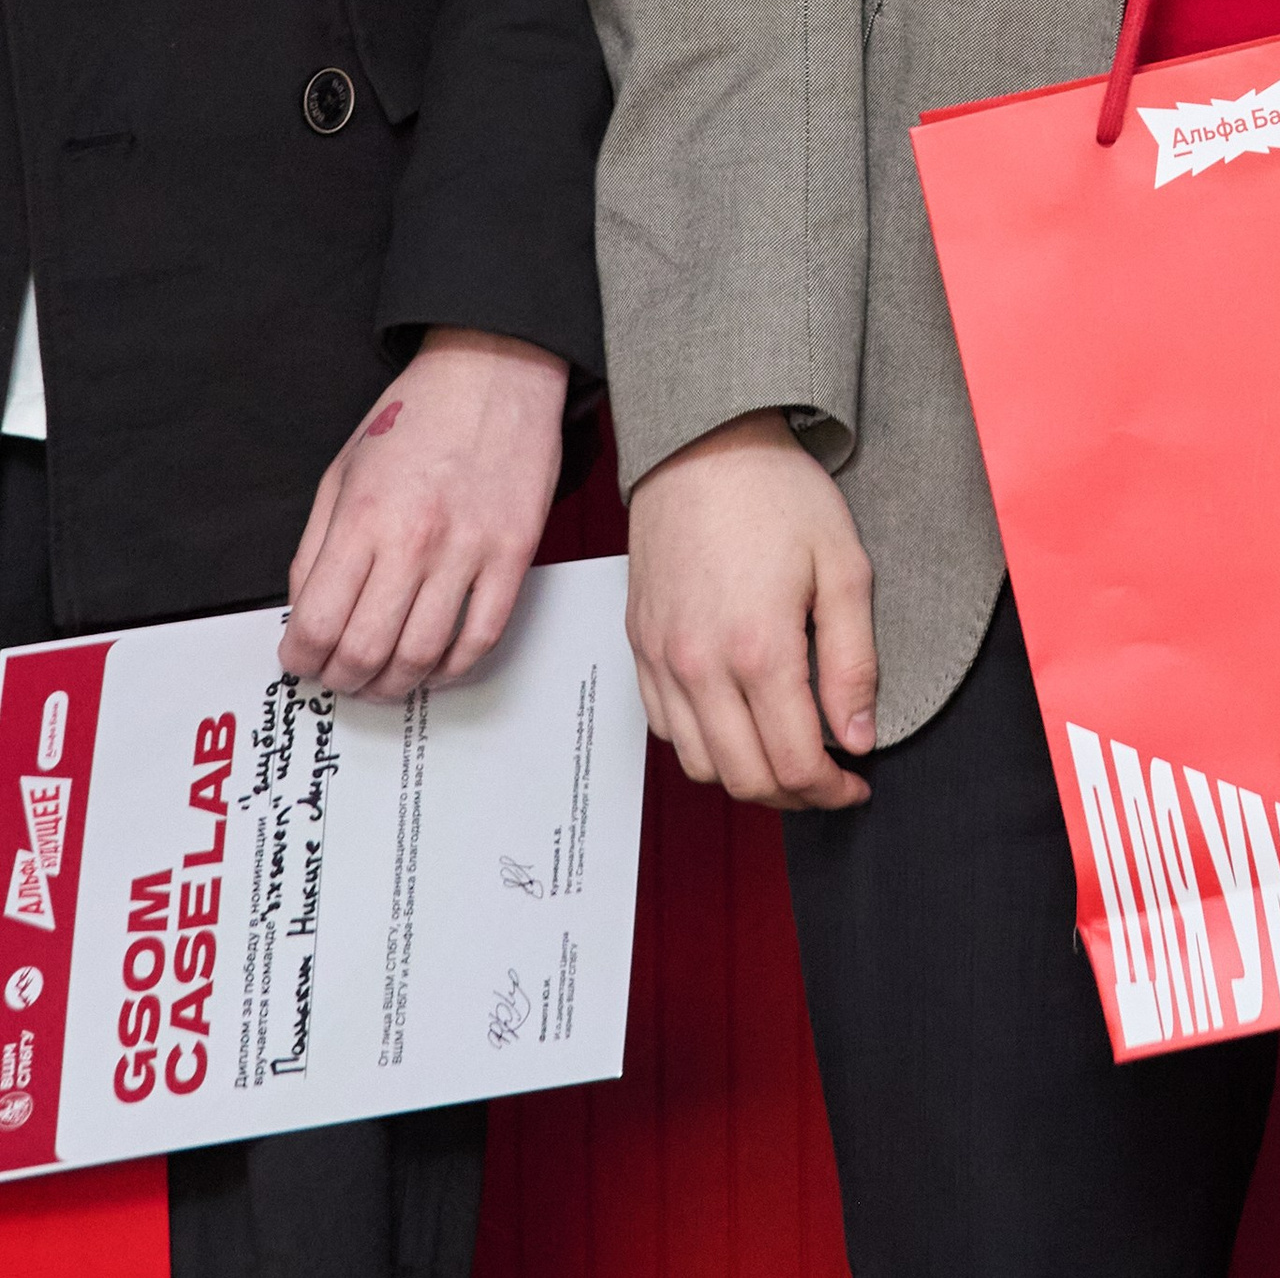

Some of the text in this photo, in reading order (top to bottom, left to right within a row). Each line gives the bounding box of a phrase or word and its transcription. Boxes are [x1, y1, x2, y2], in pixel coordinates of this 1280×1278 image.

[1172, 116, 1249, 149] Альфа
[401, 725, 413, 790] комитета
[414, 764, 424, 787] вас
[416, 744, 426, 760] за
[30, 784, 62, 869] БУДУЩЕЕ
[391, 794, 408, 920] организационного
[406, 792, 422, 873] благодарим
[17, 858, 45, 915] АЛЬФА
[164, 711, 237, 1096] CASE LAB
[1065, 721, 1224, 1050] ДЛЯ
[234, 816, 268, 1089] Диплом за победу в номинации
[400, 876, 417, 966] Альфа-Банка
[113, 867, 173, 1104] GSOM
[253, 920, 276, 1087] вручается команде
[383, 974, 395, 1011] ВШМ
[402, 970, 409, 979] и
[378, 1049, 389, 1067] От
[381, 1013, 392, 1046] лица
[392, 1030, 404, 1065] ВШМ
